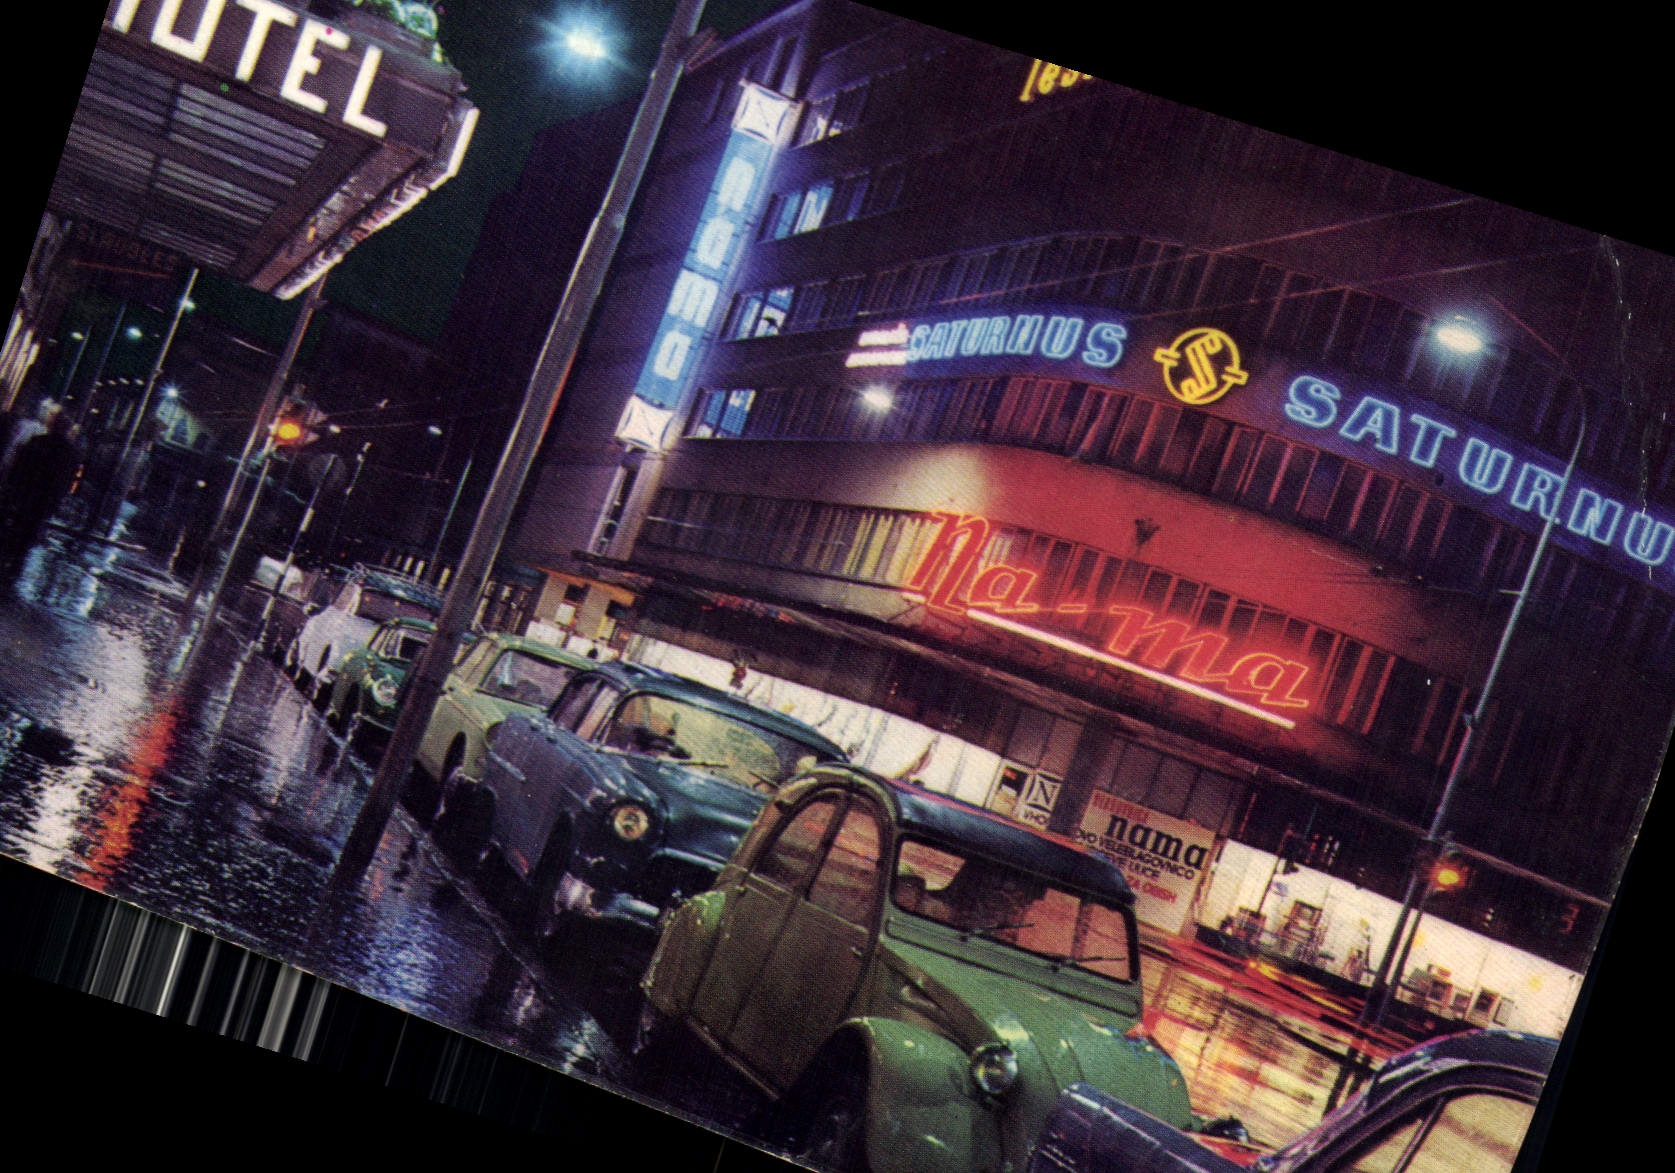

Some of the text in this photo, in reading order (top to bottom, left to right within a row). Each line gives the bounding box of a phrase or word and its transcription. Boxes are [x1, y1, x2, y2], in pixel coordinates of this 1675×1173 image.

[113, 0, 388, 138] OTEL
[905, 314, 1127, 369] SATURNUS
[1284, 375, 1675, 567] SATURNU
[1104, 813, 1209, 871] nama
